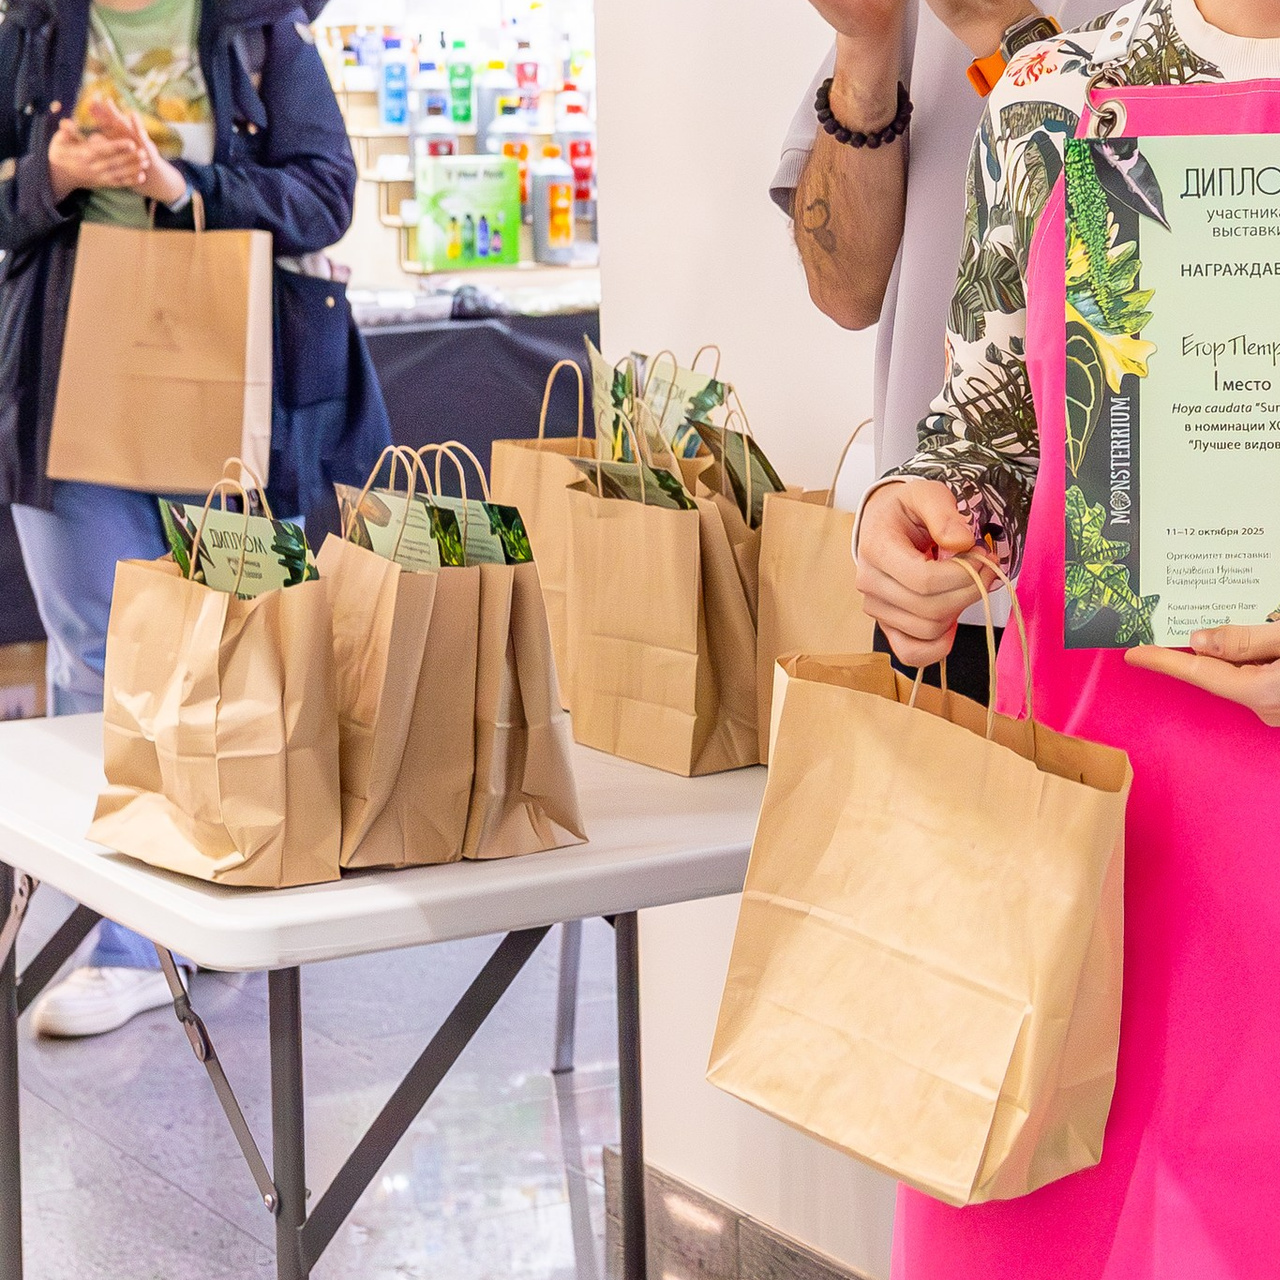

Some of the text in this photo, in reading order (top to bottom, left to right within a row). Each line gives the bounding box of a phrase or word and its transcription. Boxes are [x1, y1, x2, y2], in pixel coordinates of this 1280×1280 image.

[1182, 333, 1227, 367] Егор
[1222, 380, 1272, 391] место
[1172, 403, 1202, 416] Hoya
[1204, 403, 1253, 414] caudata
[1184, 423, 1192, 432] в
[1194, 422, 1265, 432] номинации
[1197, 527, 1239, 537] октября
[1241, 527, 1265, 536] 2025
